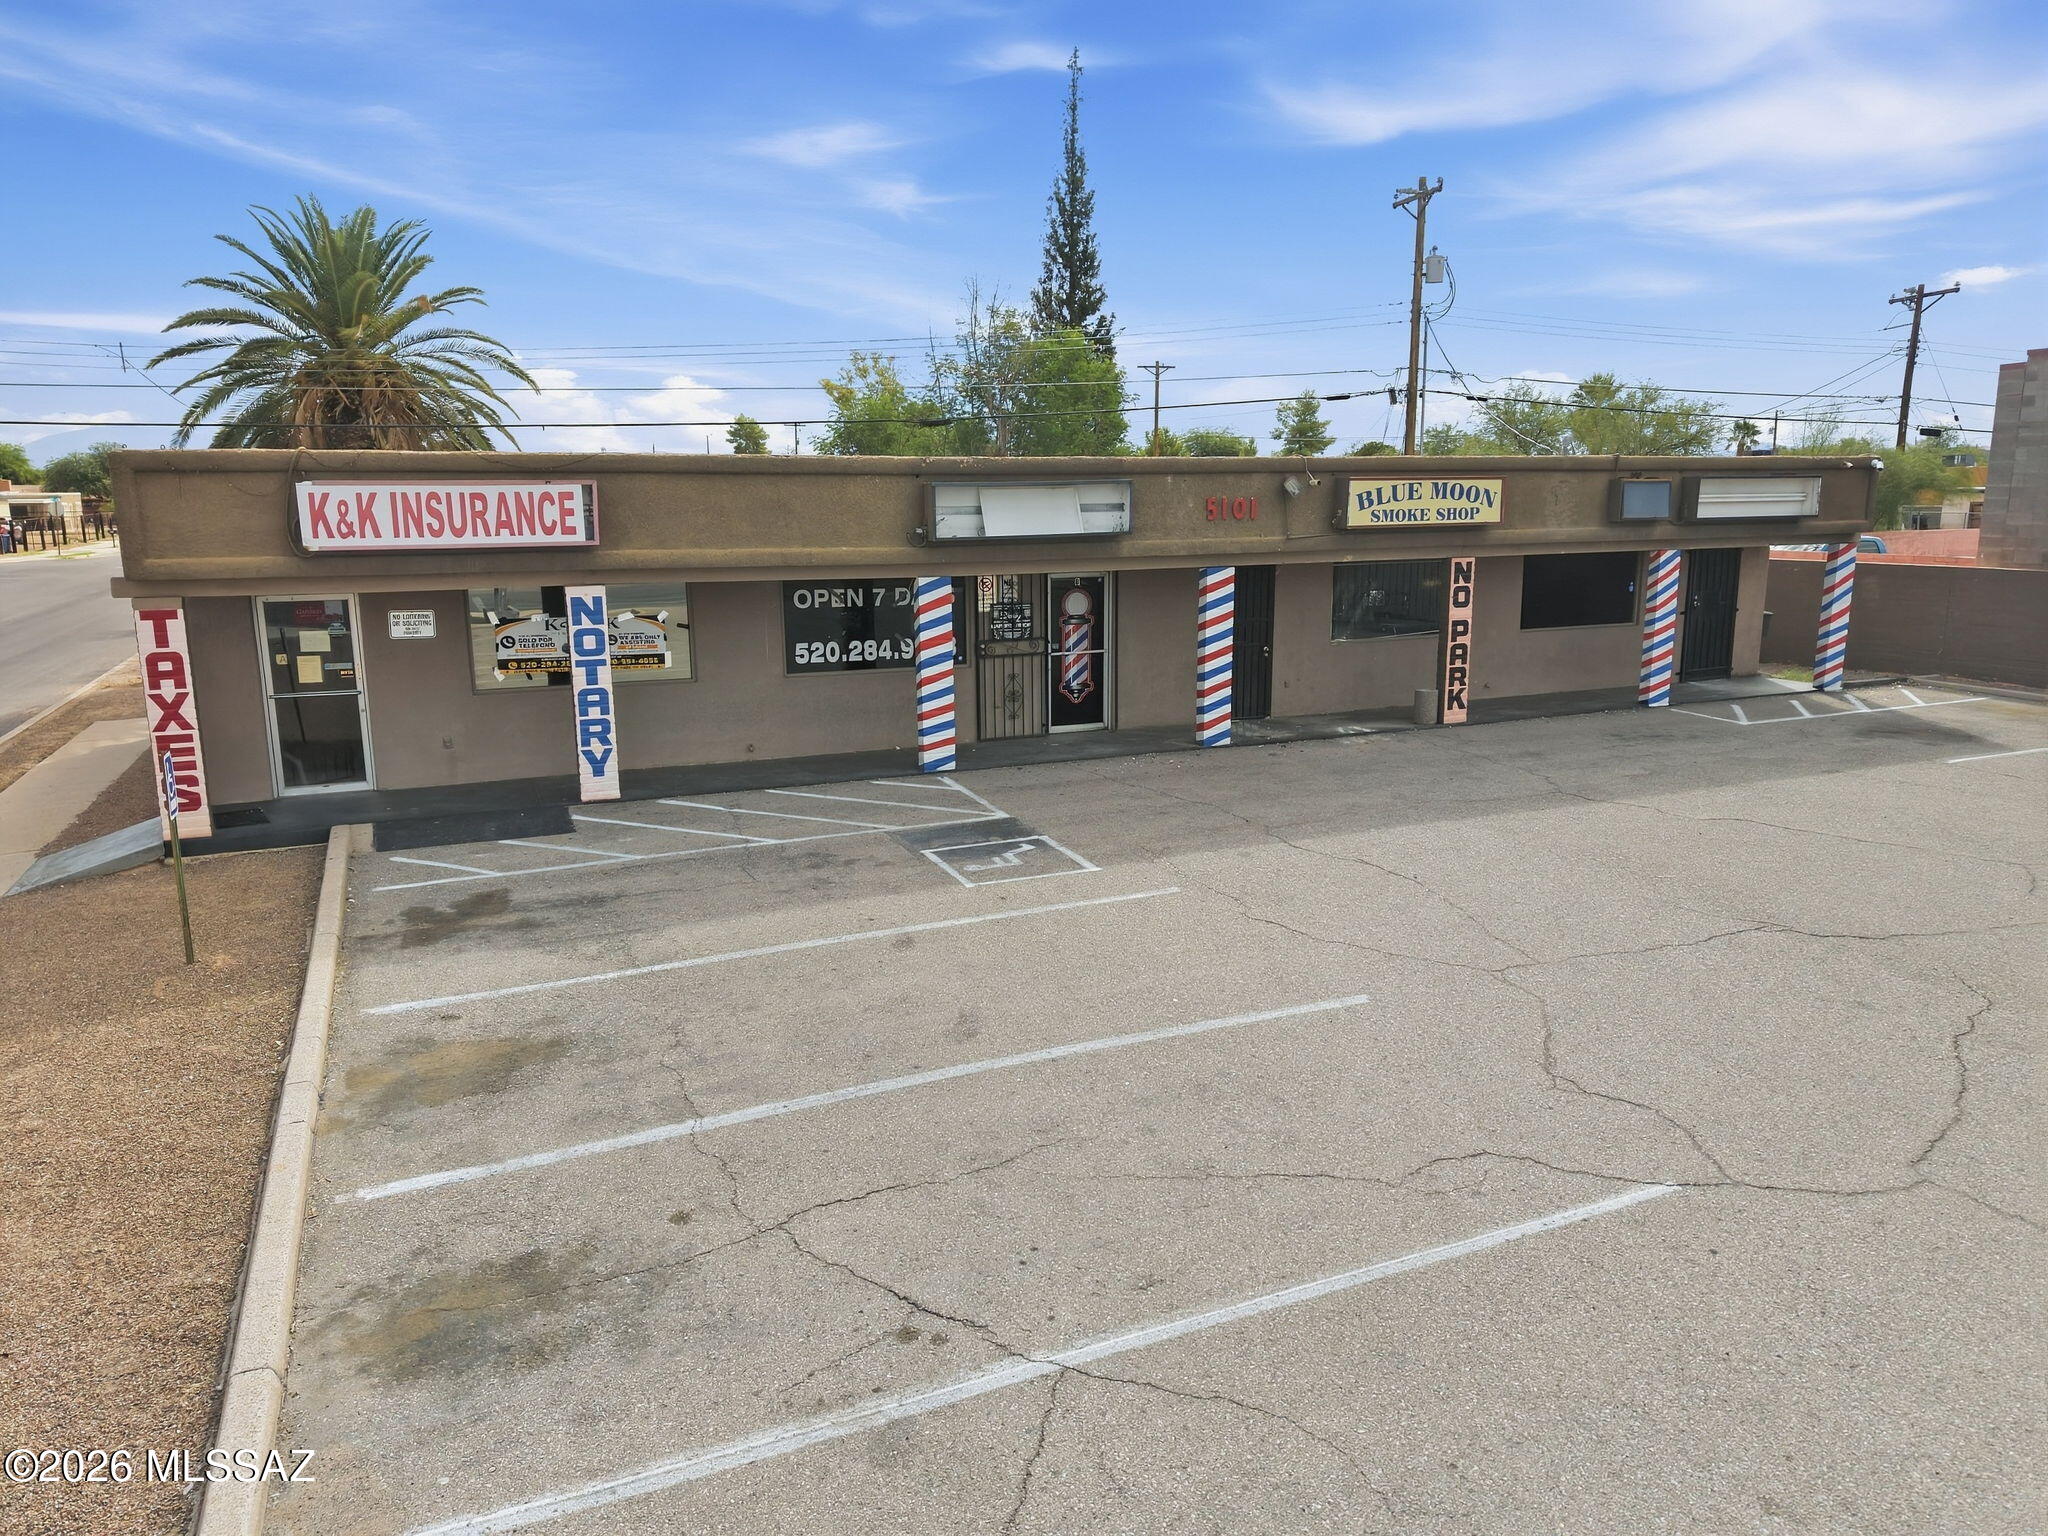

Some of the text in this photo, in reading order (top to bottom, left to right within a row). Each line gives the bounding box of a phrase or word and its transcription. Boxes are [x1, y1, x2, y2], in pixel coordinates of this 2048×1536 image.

[306, 489, 578, 540] K&K INSURANCE
[1204, 497, 1259, 521] 5101
[1355, 481, 1499, 512] BLUE MOON
[1370, 506, 1481, 524] SMOKE SHOP
[793, 588, 864, 609] OPEN
[872, 588, 886, 607] 7
[1447, 561, 1473, 711] NO PARK
[570, 595, 614, 778] NOTARY
[138, 608, 203, 814] TAXES
